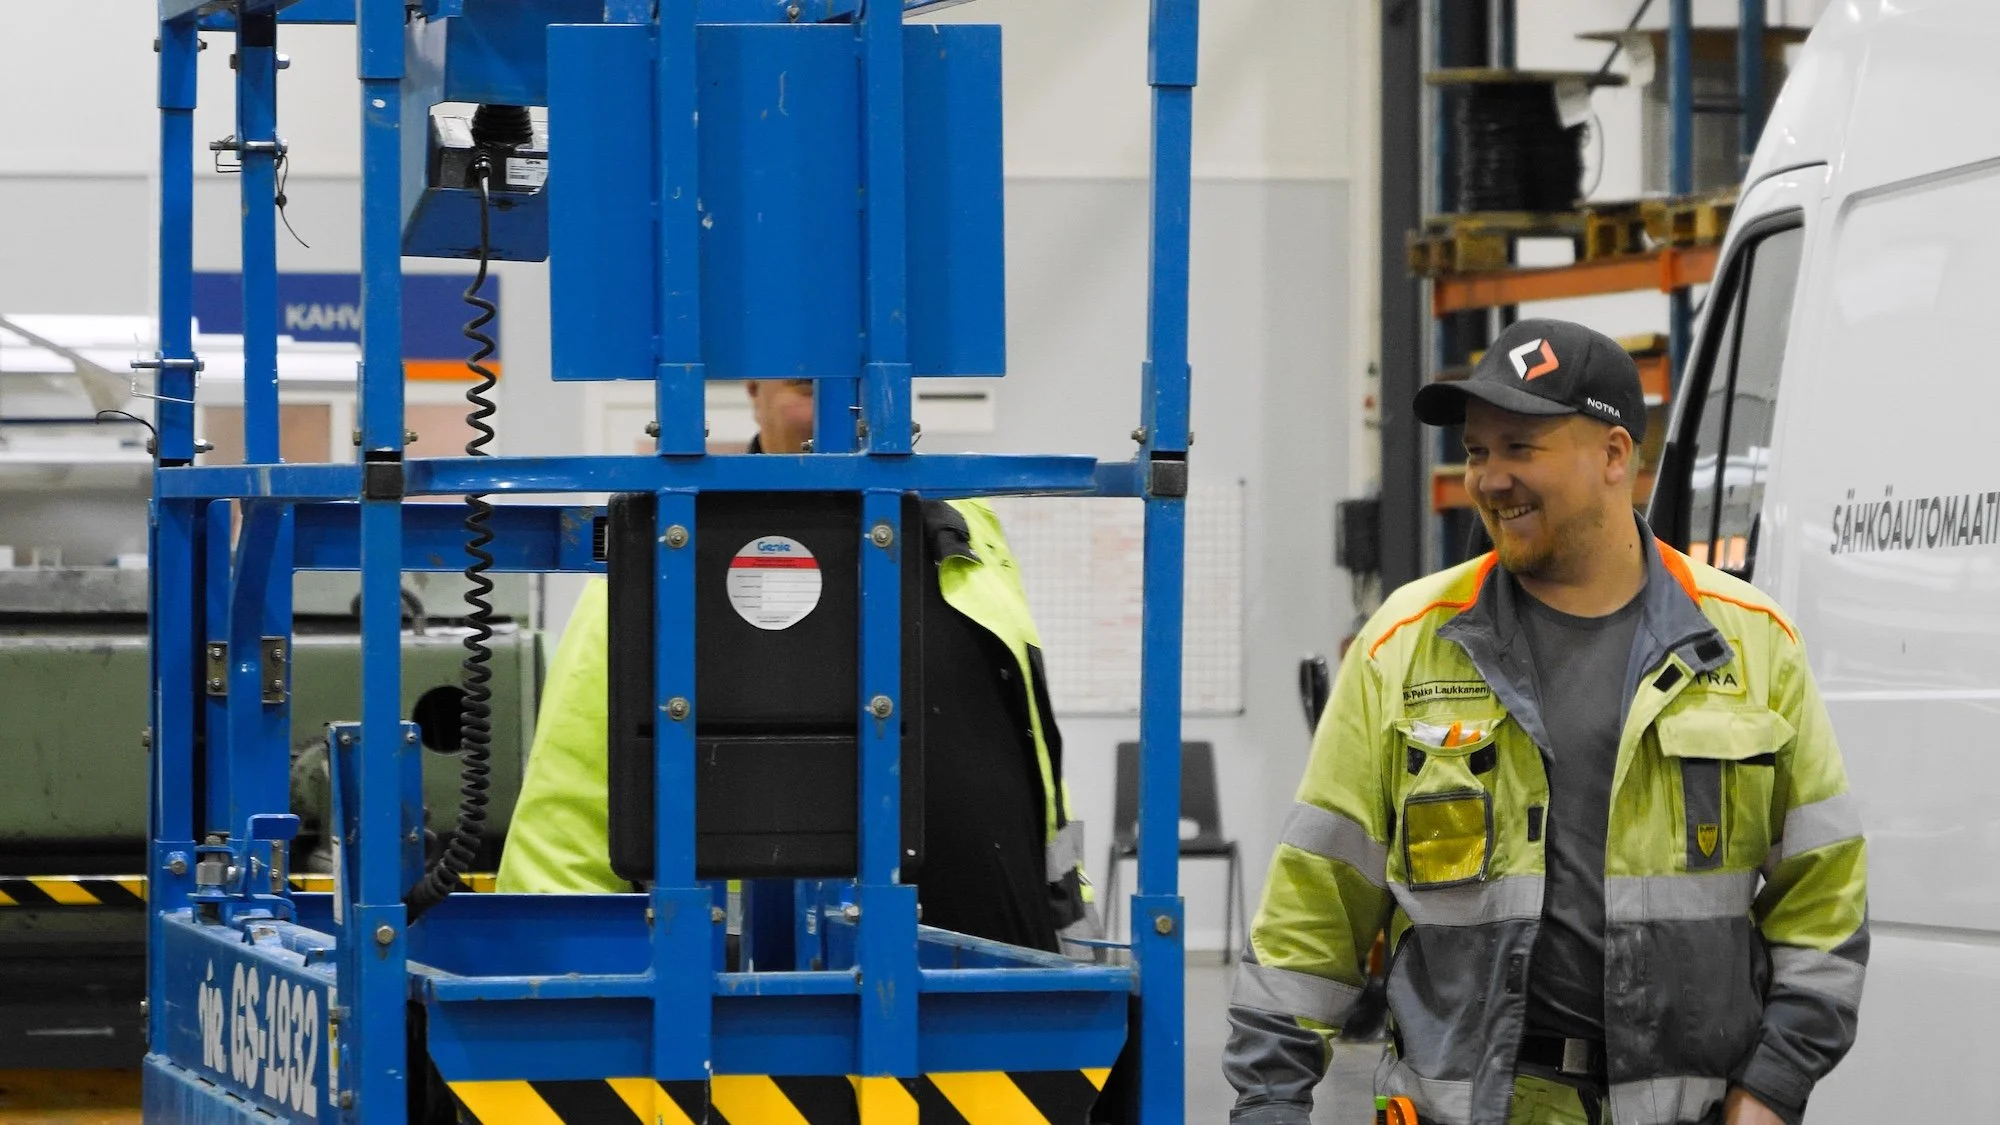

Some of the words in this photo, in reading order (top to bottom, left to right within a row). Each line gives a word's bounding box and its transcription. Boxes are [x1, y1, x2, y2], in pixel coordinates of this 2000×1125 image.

[1587, 397, 1621, 418] NOTRA
[757, 542, 791, 553] Genie
[1435, 685, 1486, 694] Laukkanen
[231, 962, 318, 1118] GS-1932
